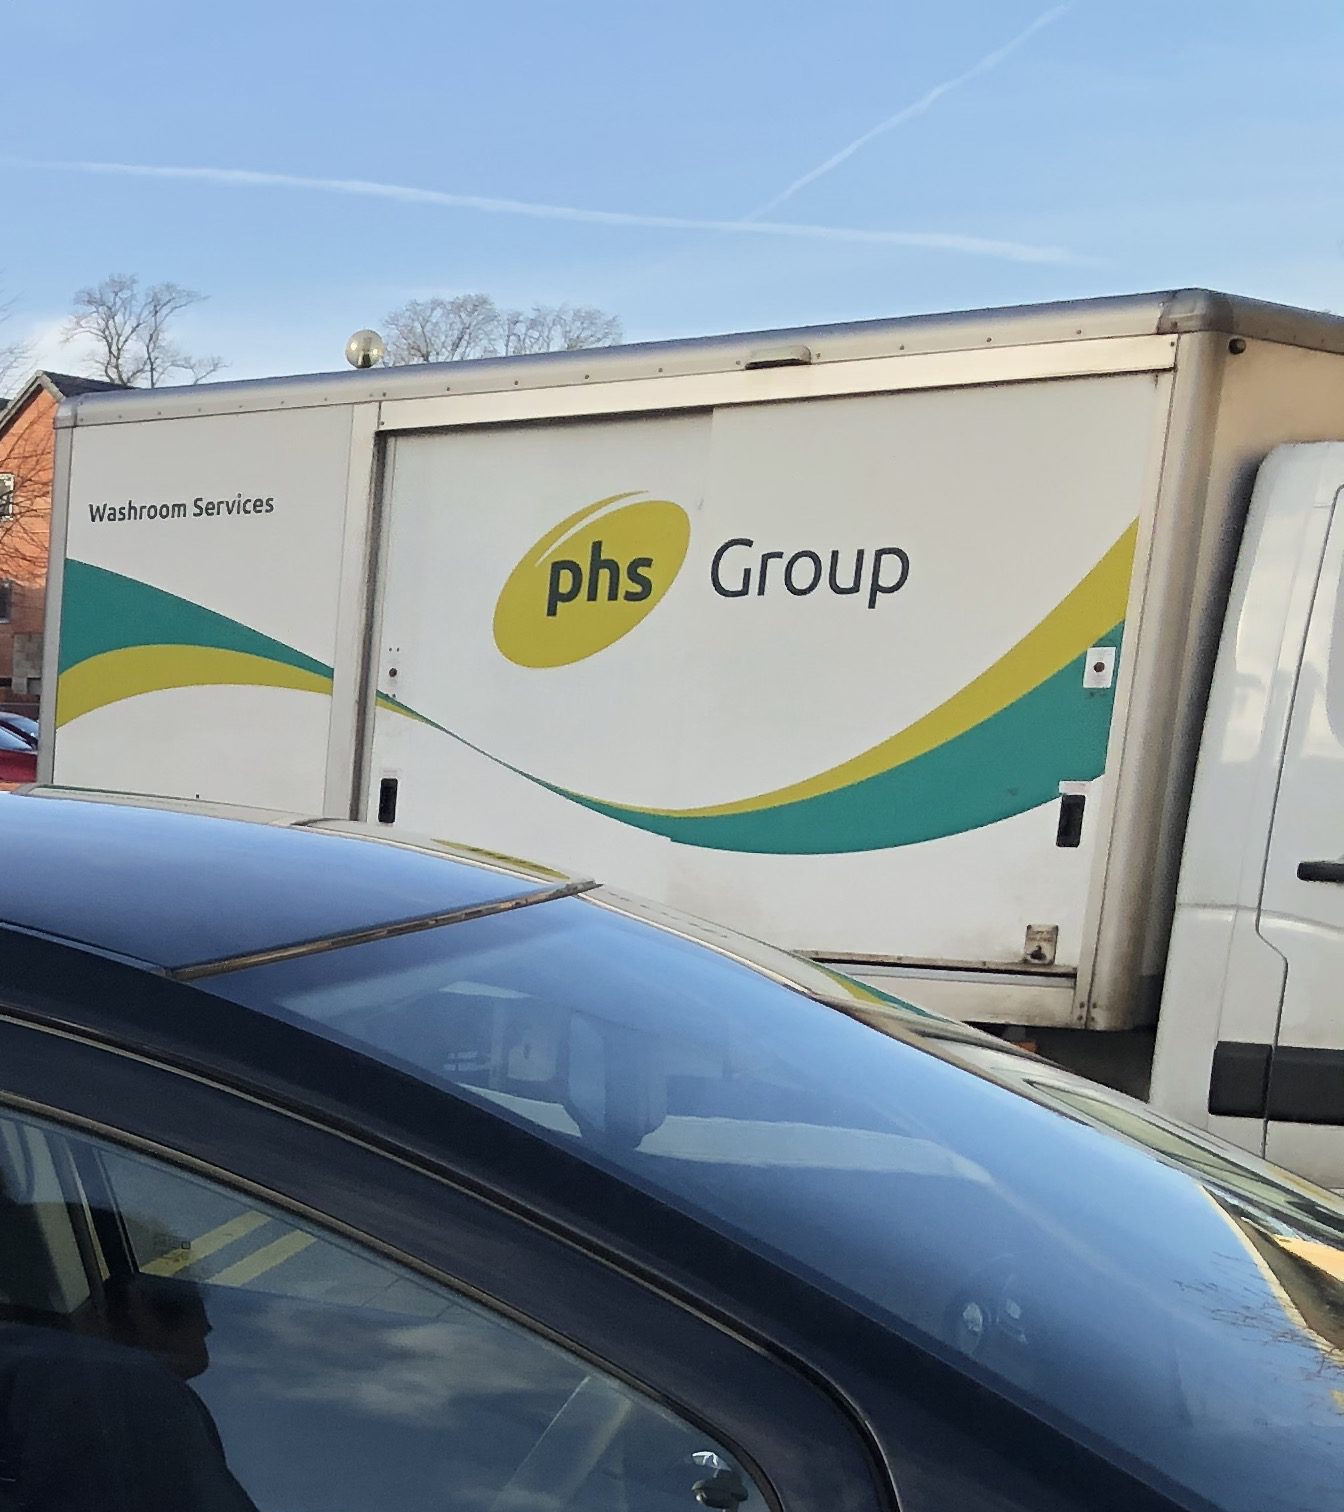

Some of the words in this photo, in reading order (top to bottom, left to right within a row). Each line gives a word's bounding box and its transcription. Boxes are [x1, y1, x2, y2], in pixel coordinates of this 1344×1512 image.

[88, 500, 187, 523] Washroom
[192, 493, 275, 518] Services
[546, 540, 654, 617] phs
[710, 537, 911, 610] Group
